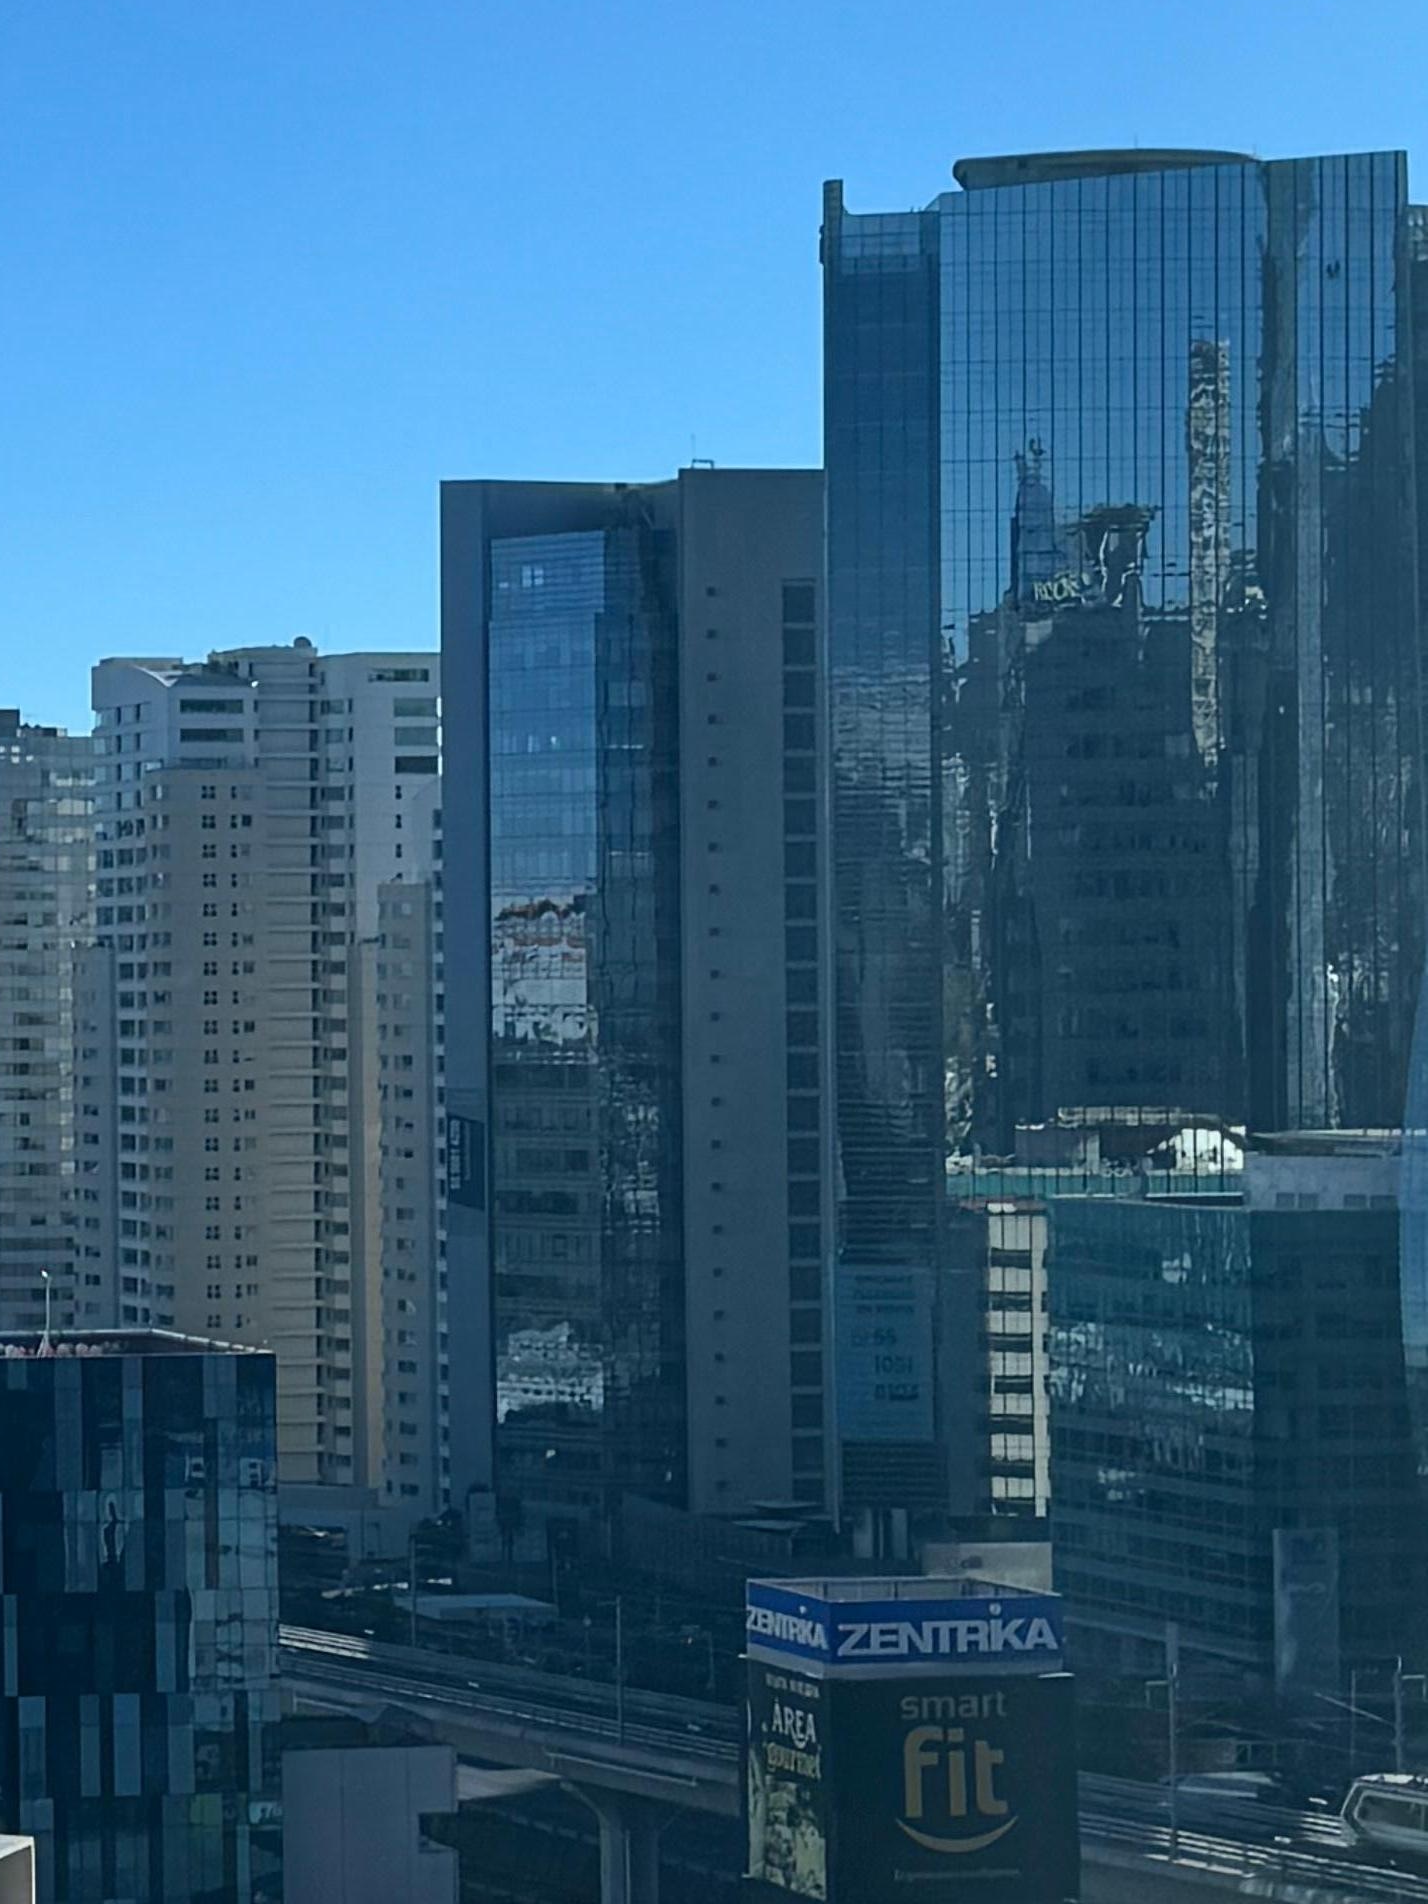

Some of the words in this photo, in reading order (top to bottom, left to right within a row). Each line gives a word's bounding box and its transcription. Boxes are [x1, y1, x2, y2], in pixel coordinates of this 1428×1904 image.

[746, 1604, 829, 1650] ZENTRIKA
[838, 1603, 1059, 1656] ZENTRIKA
[900, 1692, 1008, 1720] smart
[904, 1726, 1009, 1818] fit
